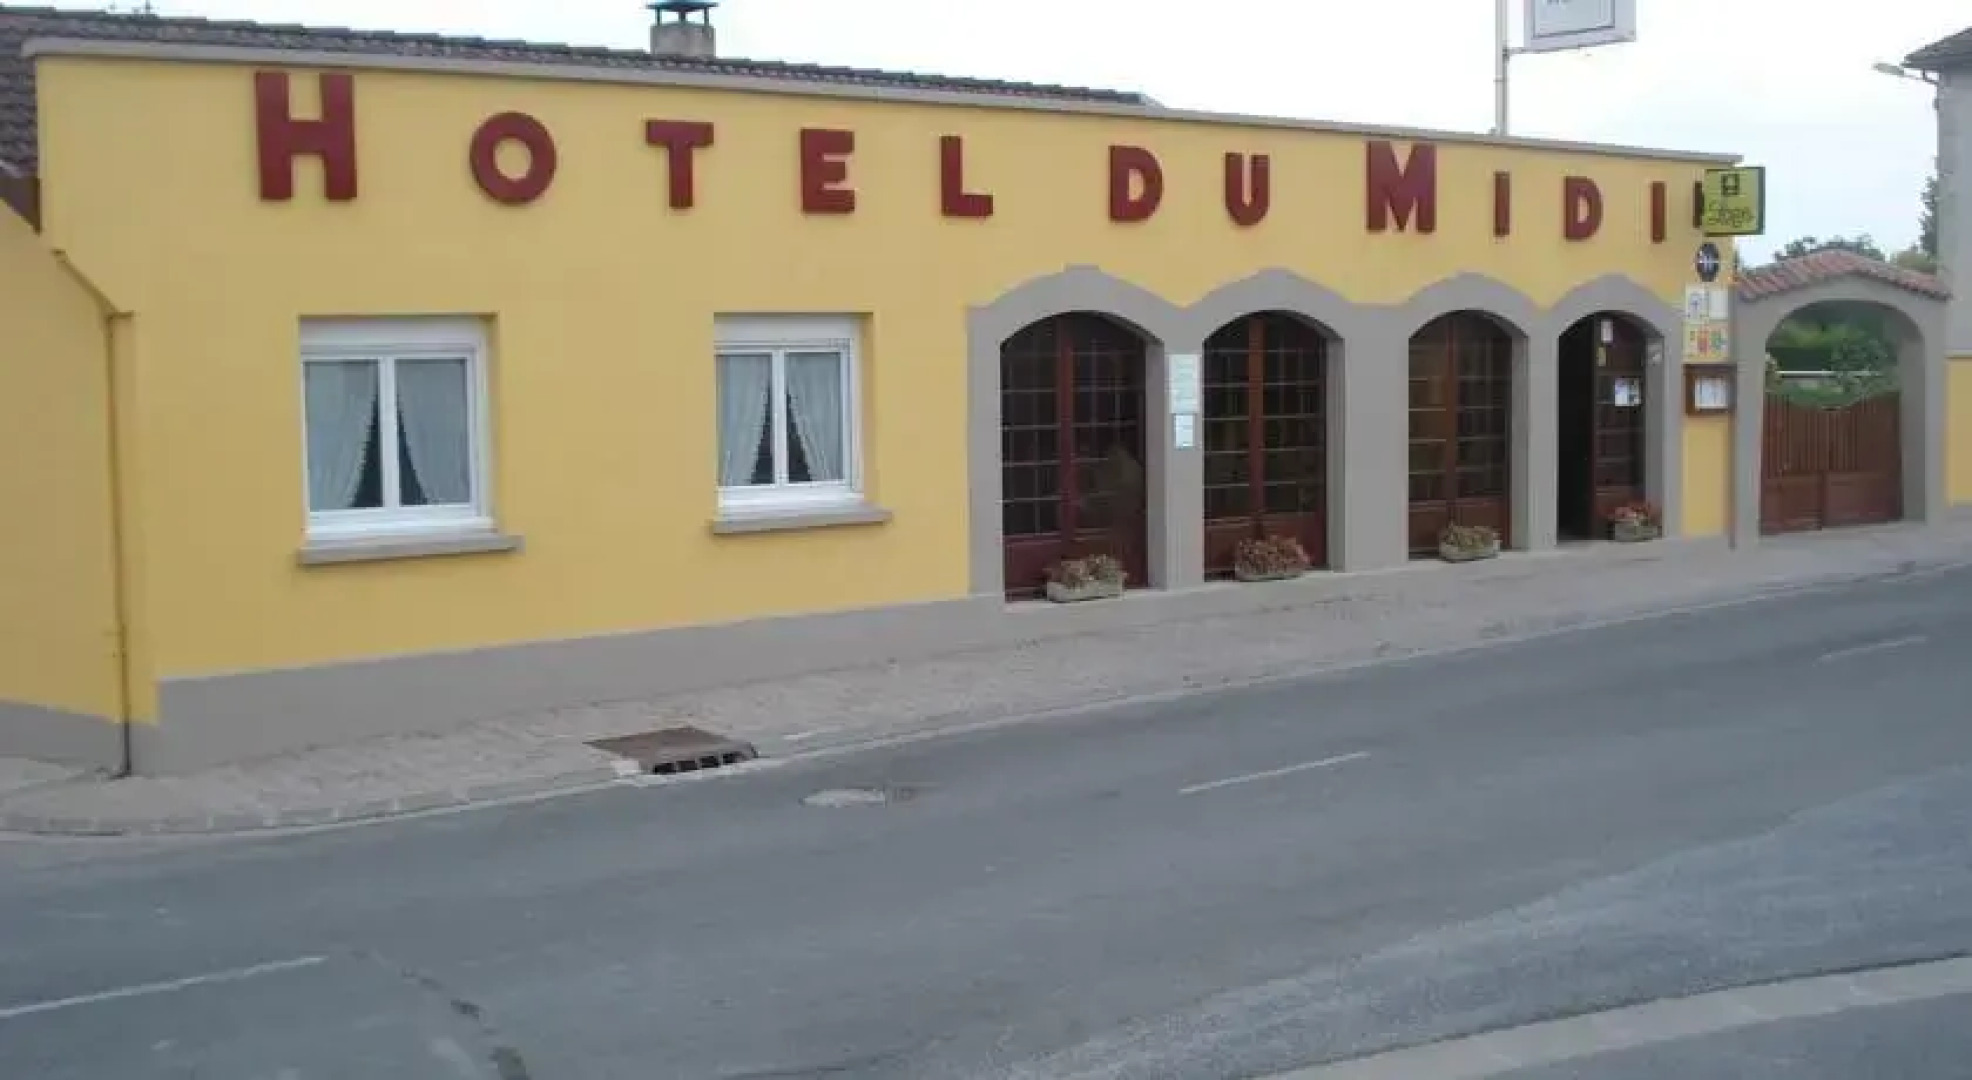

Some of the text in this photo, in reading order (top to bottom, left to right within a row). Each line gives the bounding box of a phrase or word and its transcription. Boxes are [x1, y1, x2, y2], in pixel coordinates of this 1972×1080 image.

[255, 70, 1666, 243] HOTEL DU MIDI
